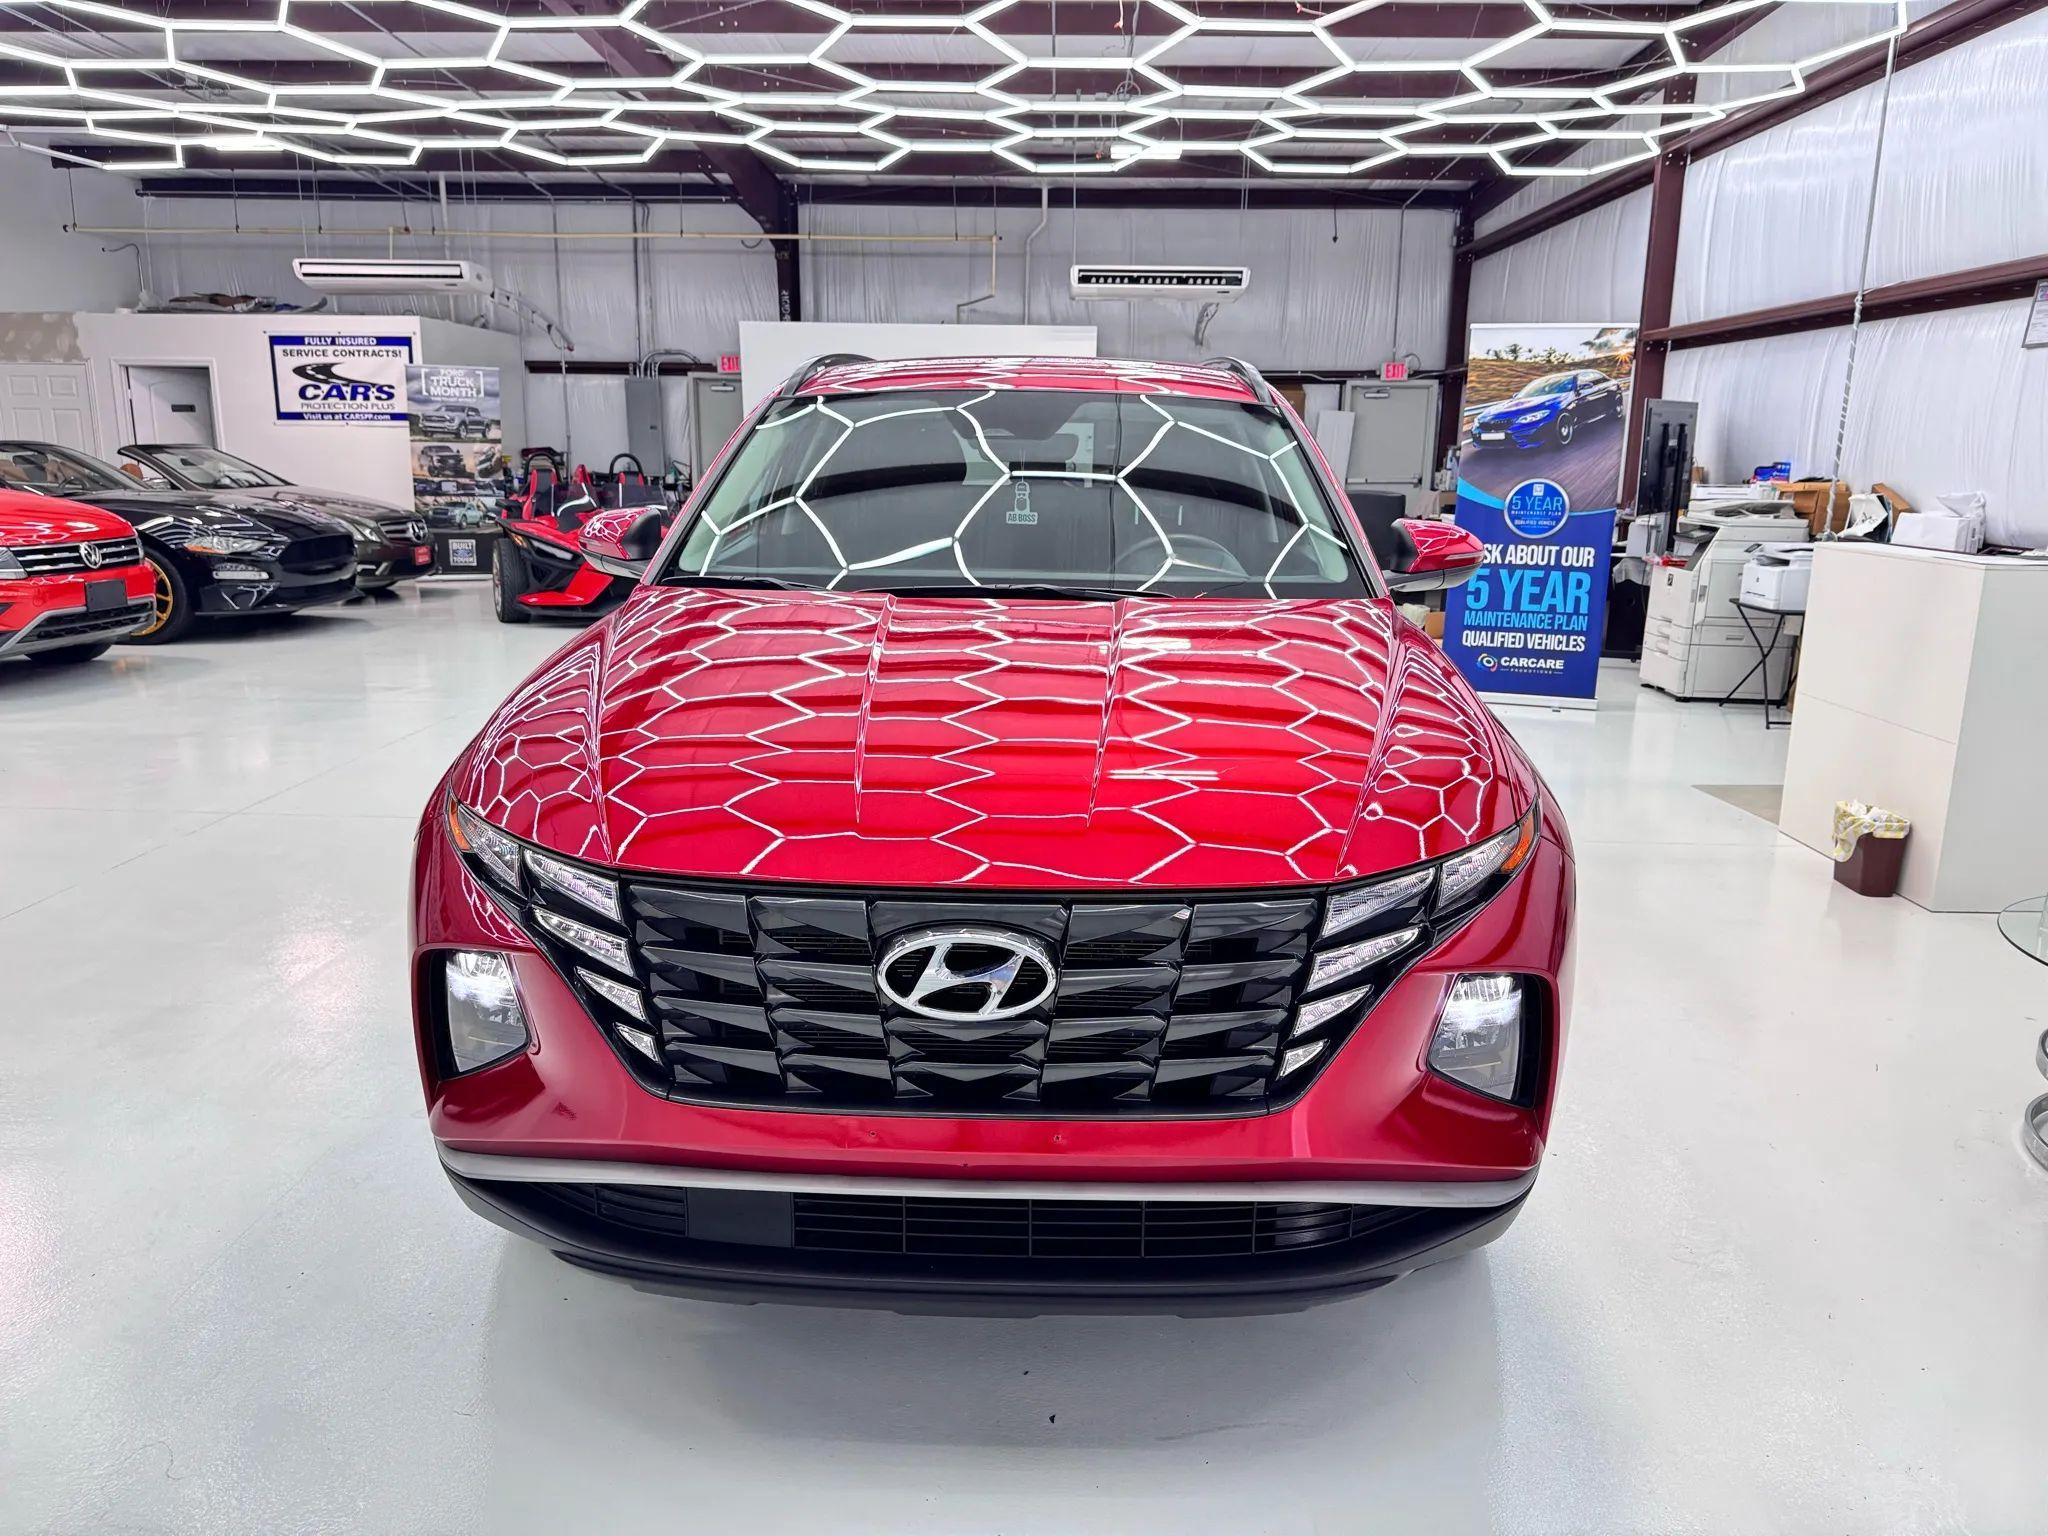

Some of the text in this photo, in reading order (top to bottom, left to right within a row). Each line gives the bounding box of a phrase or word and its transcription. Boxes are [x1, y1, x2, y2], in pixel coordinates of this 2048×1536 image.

[304, 336, 377, 346] FULLY INSURED
[282, 349, 402, 358] SERVICE CONTRACTS!
[1385, 363, 1404, 378] EXIT
[430, 376, 474, 388] TRUCK
[430, 386, 477, 398] MONTH
[301, 402, 396, 411] PROTECTION PLUS
[1511, 496, 1563, 511] 5 YEAR
[1007, 513, 1036, 523] AB BOSS
[1483, 543, 1596, 567] SK ABOUT OUR
[1466, 568, 1592, 614] 5 YEAR
[1463, 610, 1588, 631] MAINTENANCE PLAN
[1462, 629, 1586, 652] QUALIFIED VEHICLES
[1500, 656, 1565, 669] CARCARE
